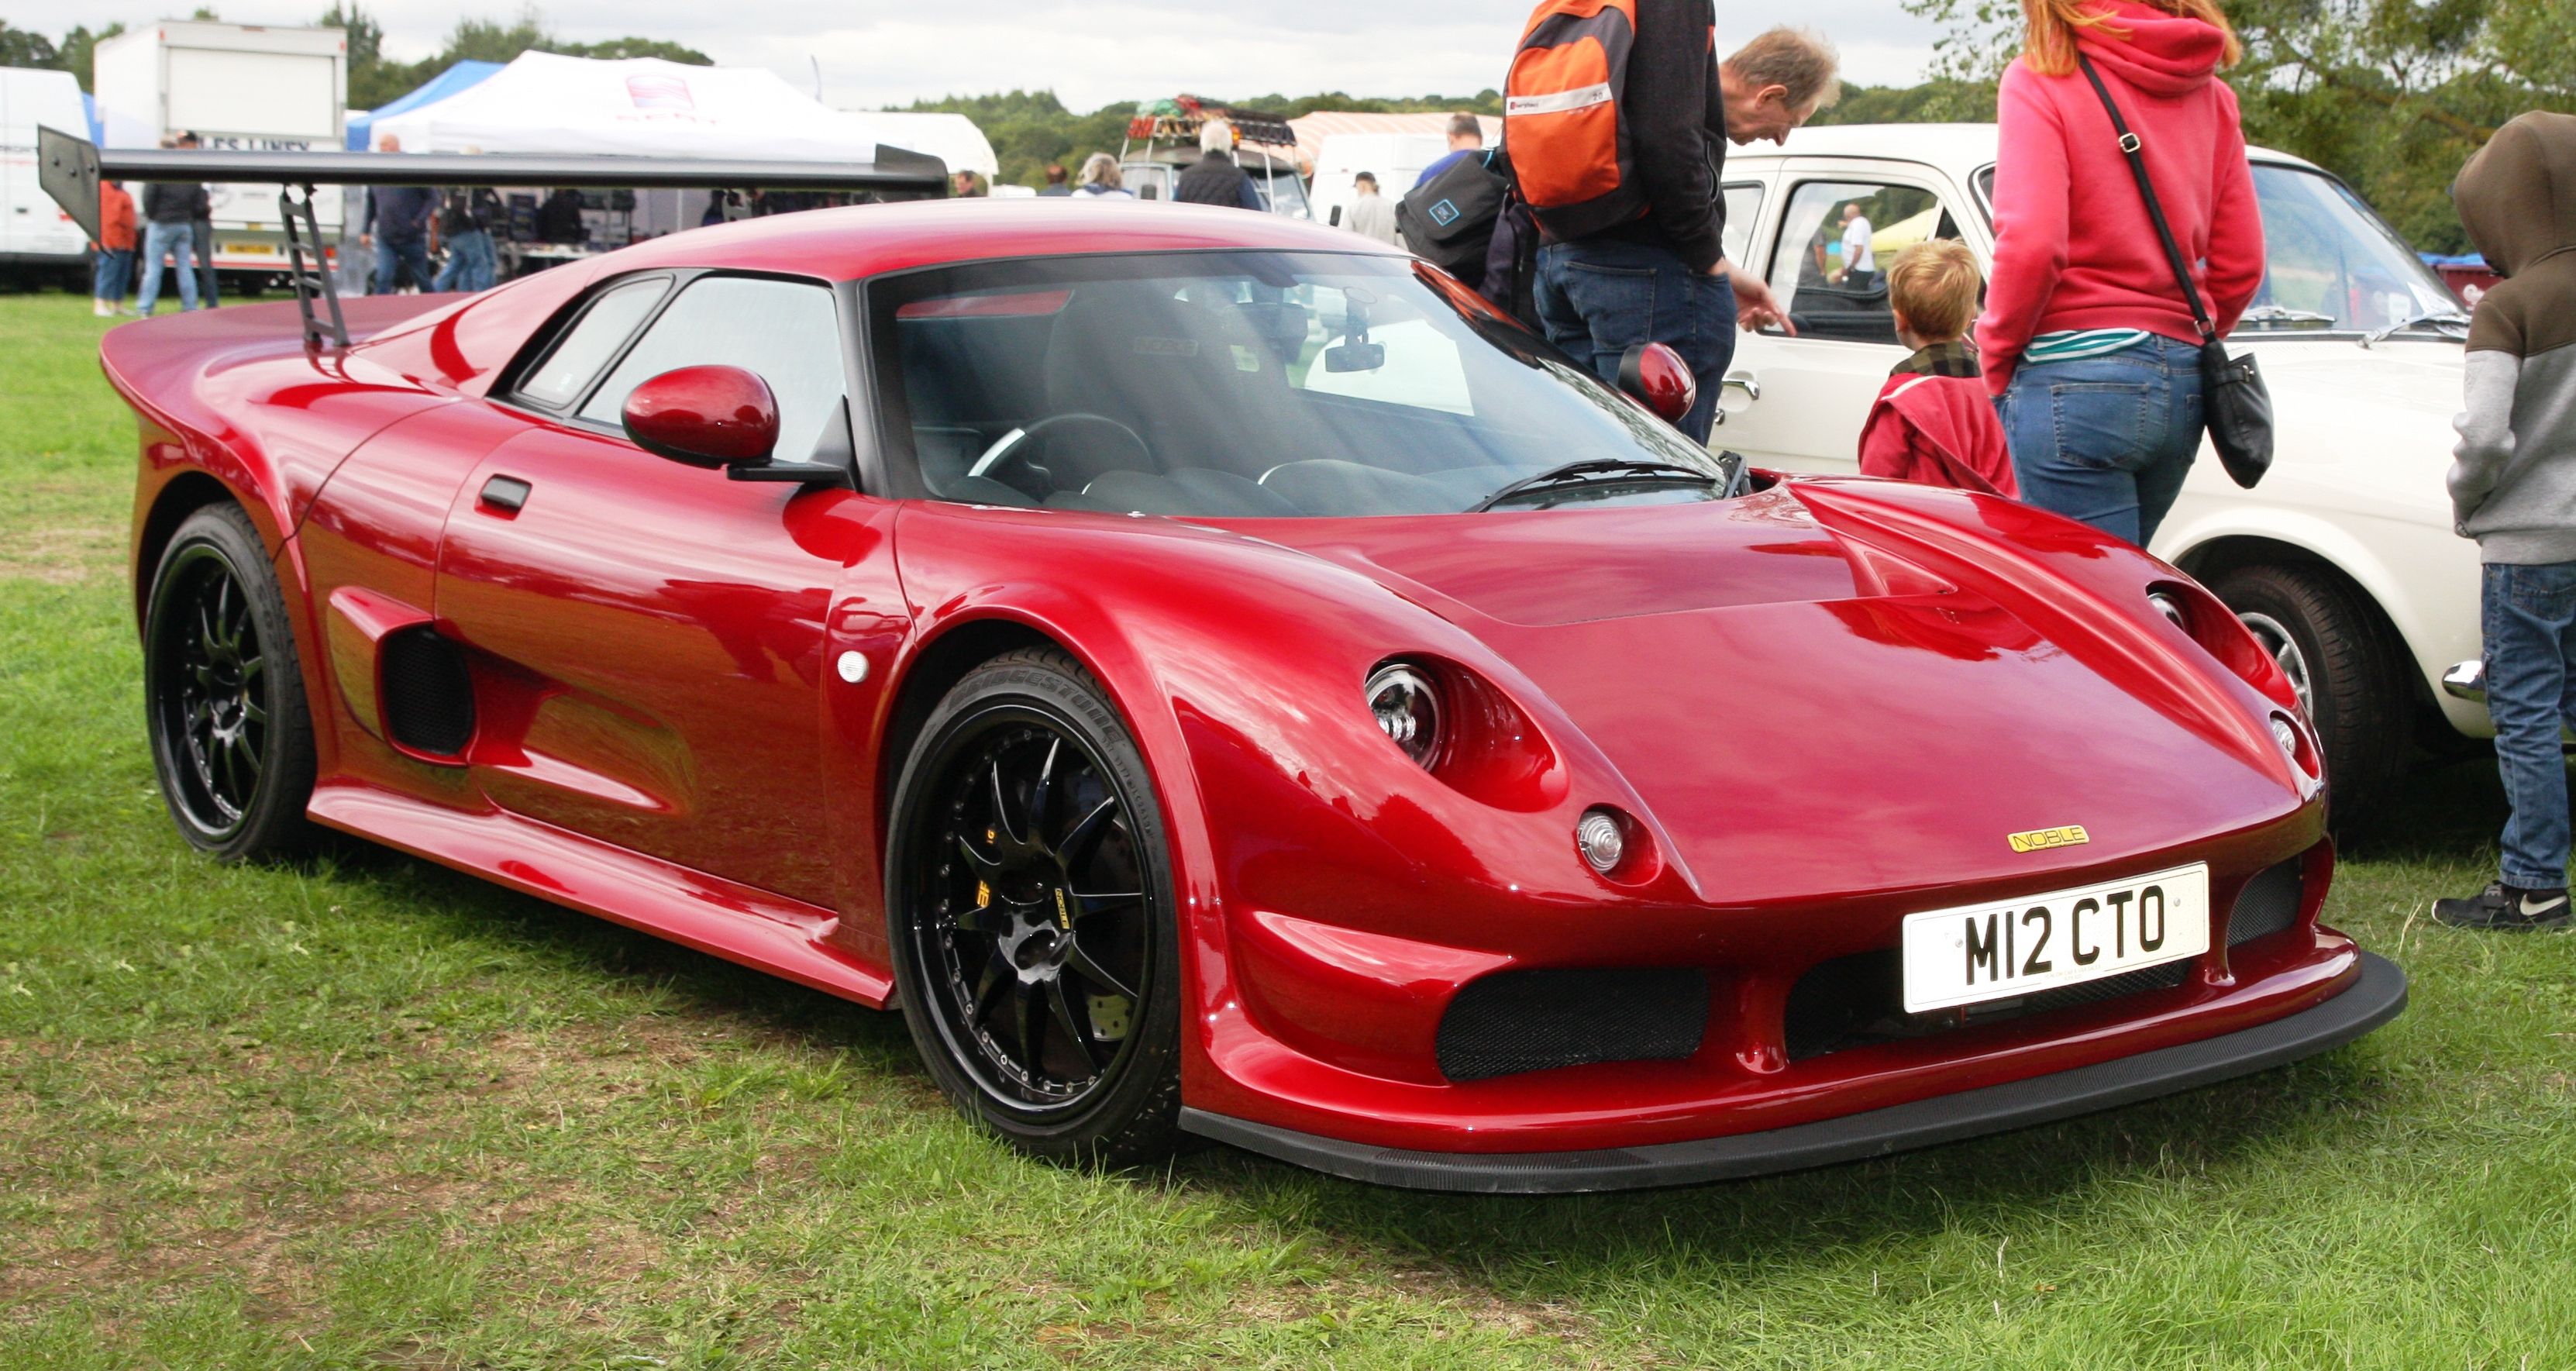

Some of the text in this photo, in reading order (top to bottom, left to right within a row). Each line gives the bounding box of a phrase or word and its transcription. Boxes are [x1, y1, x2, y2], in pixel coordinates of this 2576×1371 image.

[1593, 91, 1603, 102] 20
[2012, 826, 2087, 849] NOBLE
[2071, 885, 2164, 966] CTO
